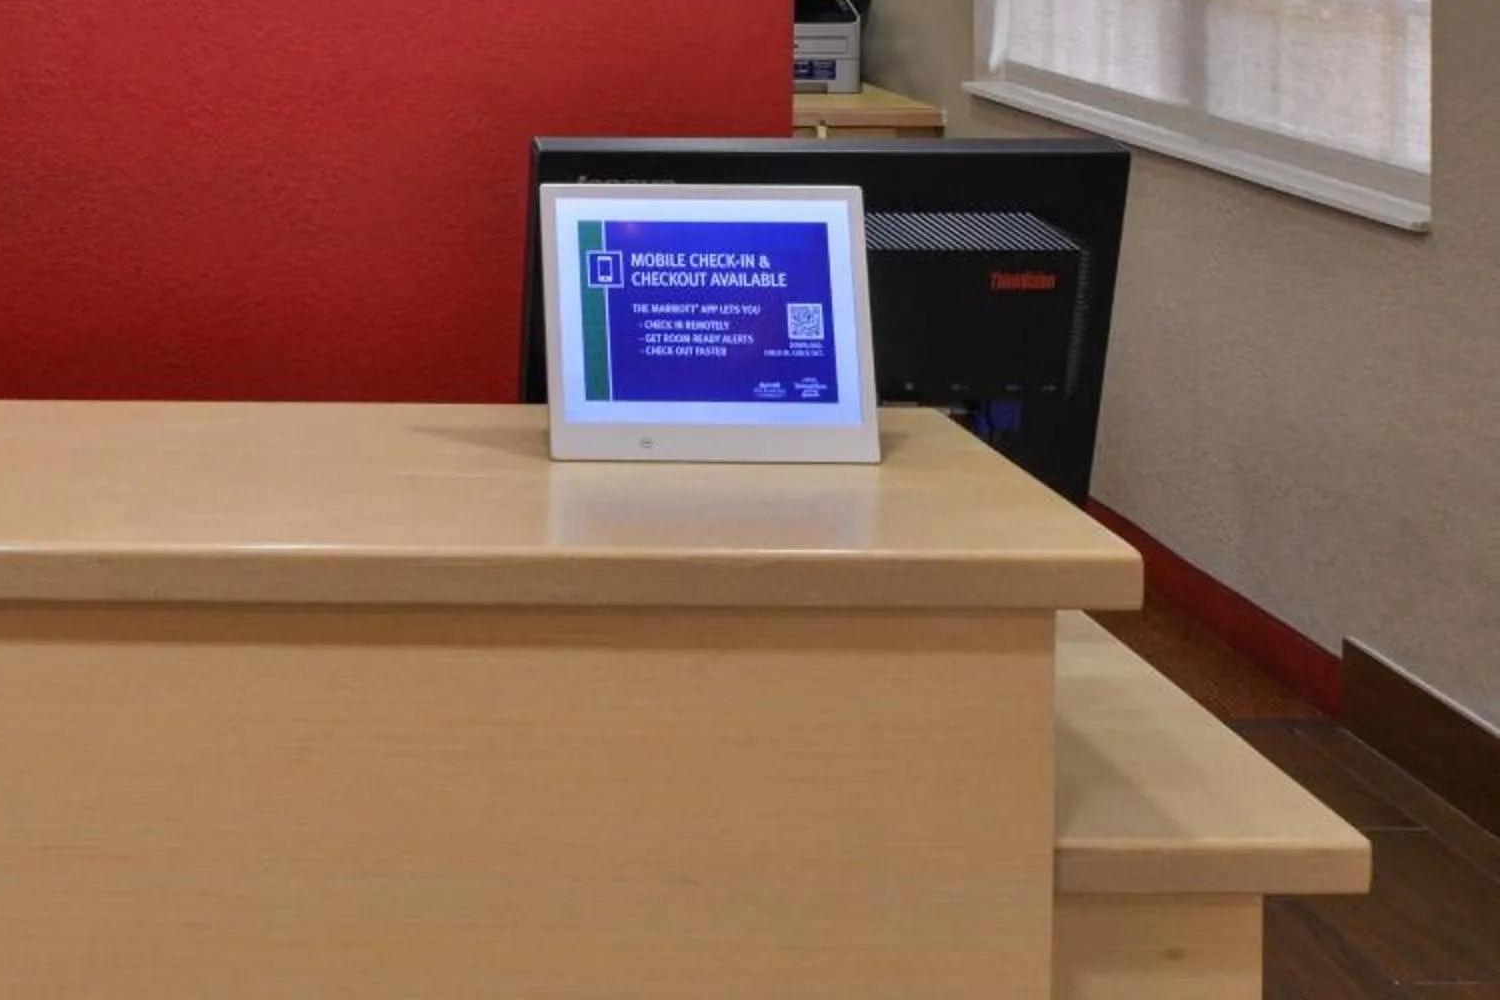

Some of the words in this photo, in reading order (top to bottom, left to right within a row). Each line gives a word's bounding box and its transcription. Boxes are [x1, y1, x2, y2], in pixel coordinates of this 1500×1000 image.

[631, 253, 686, 268] MOBILE
[689, 253, 755, 269] CHECK-IN
[758, 255, 771, 269] &
[631, 271, 707, 287] CHECKOUT
[710, 272, 788, 288] AVAILABLE
